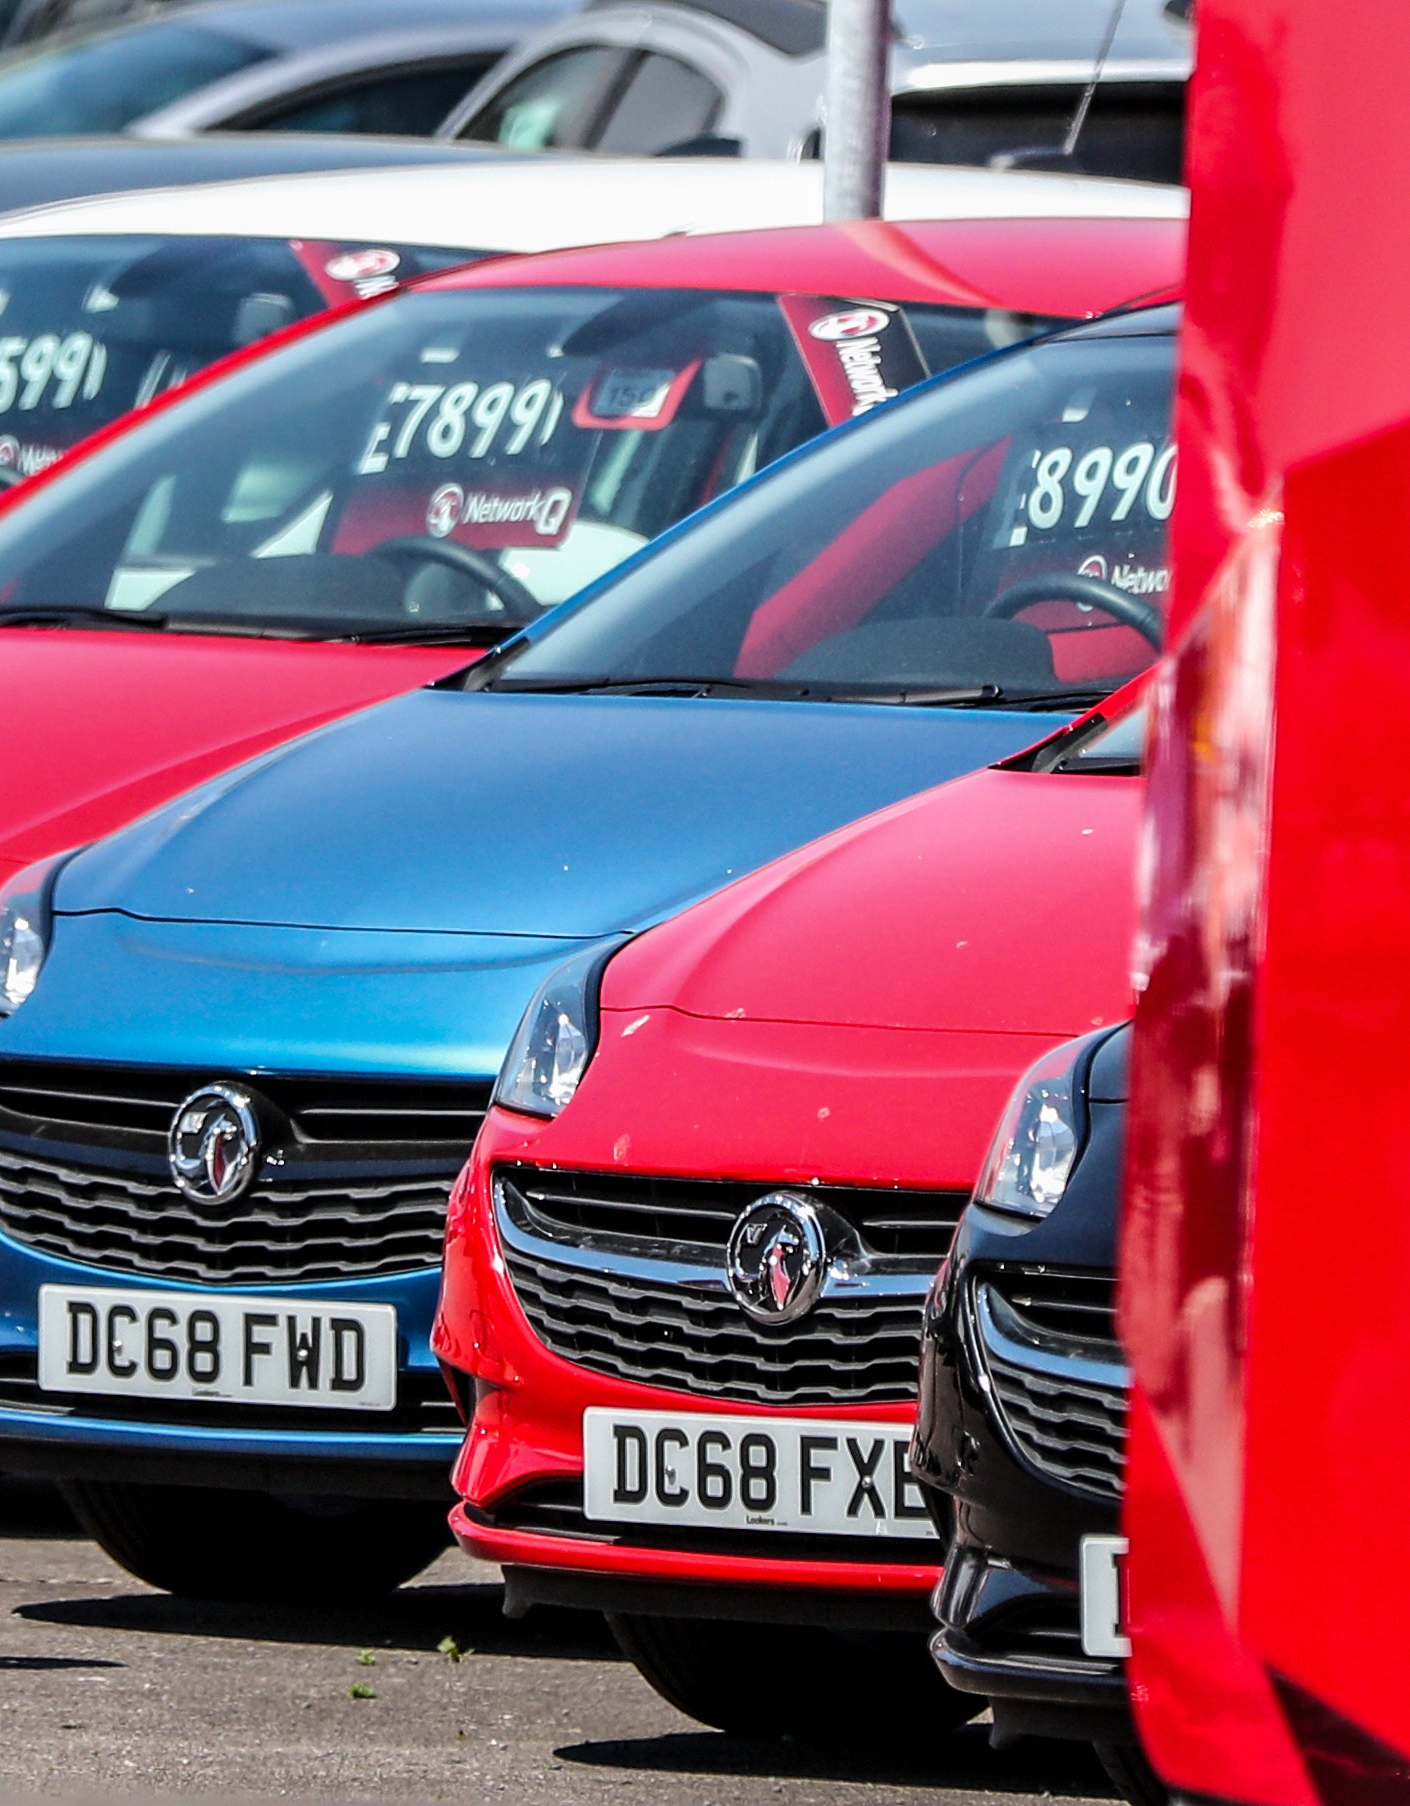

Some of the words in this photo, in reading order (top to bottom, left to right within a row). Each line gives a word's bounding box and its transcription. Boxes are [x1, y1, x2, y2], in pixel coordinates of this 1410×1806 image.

[66, 1301, 220, 1384] DC68
[242, 1313, 365, 1392] FWD
[612, 1424, 777, 1512] DC68
